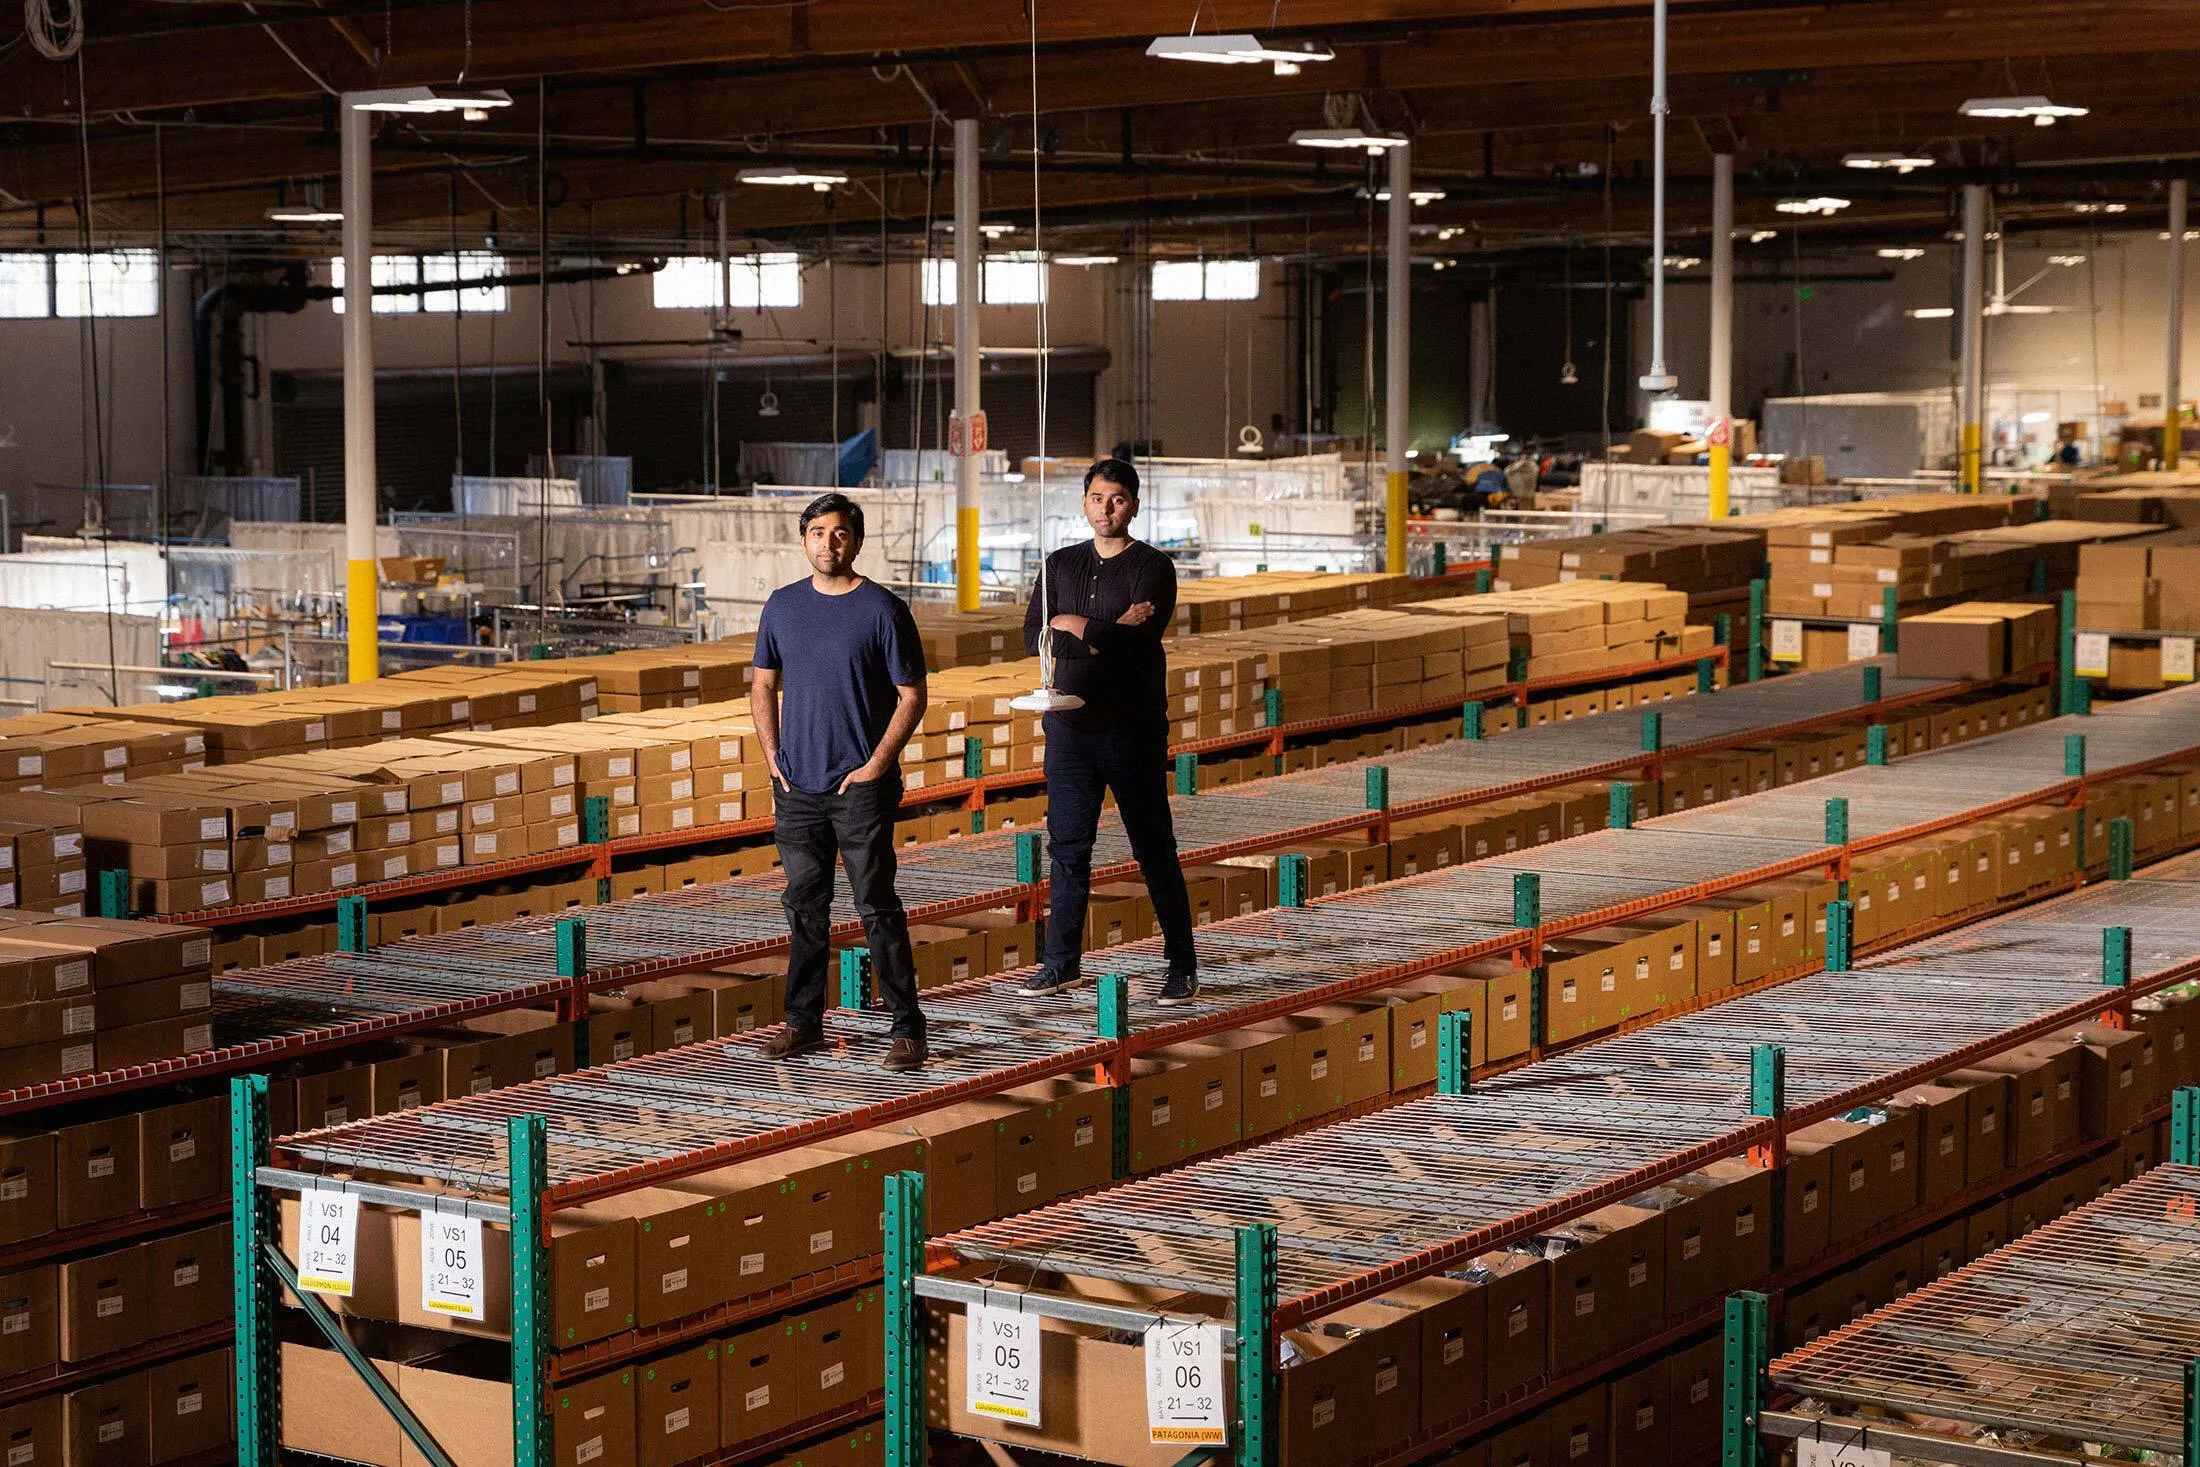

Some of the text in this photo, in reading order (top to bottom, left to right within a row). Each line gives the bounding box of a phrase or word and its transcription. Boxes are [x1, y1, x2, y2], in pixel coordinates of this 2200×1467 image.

[321, 1203, 343, 1218] VS1
[321, 1225, 340, 1245] 04
[443, 1226, 466, 1242] VS1
[313, 1251, 323, 1262] 21
[335, 1253, 346, 1265] 32
[445, 1248, 467, 1269] 05
[438, 1273, 449, 1285] 21
[462, 1277, 475, 1290] 32
[993, 1321, 1020, 1339] VS1
[995, 1345, 1020, 1369] 05
[1172, 1341, 1201, 1356] VS1
[986, 1372, 999, 1386] 21
[1014, 1377, 1029, 1392] 32
[1175, 1365, 1201, 1388] 06
[1167, 1397, 1181, 1410] 21
[1197, 1397, 1212, 1410] 32
[1152, 1430, 1223, 1441] PATAGONIA (WW)
